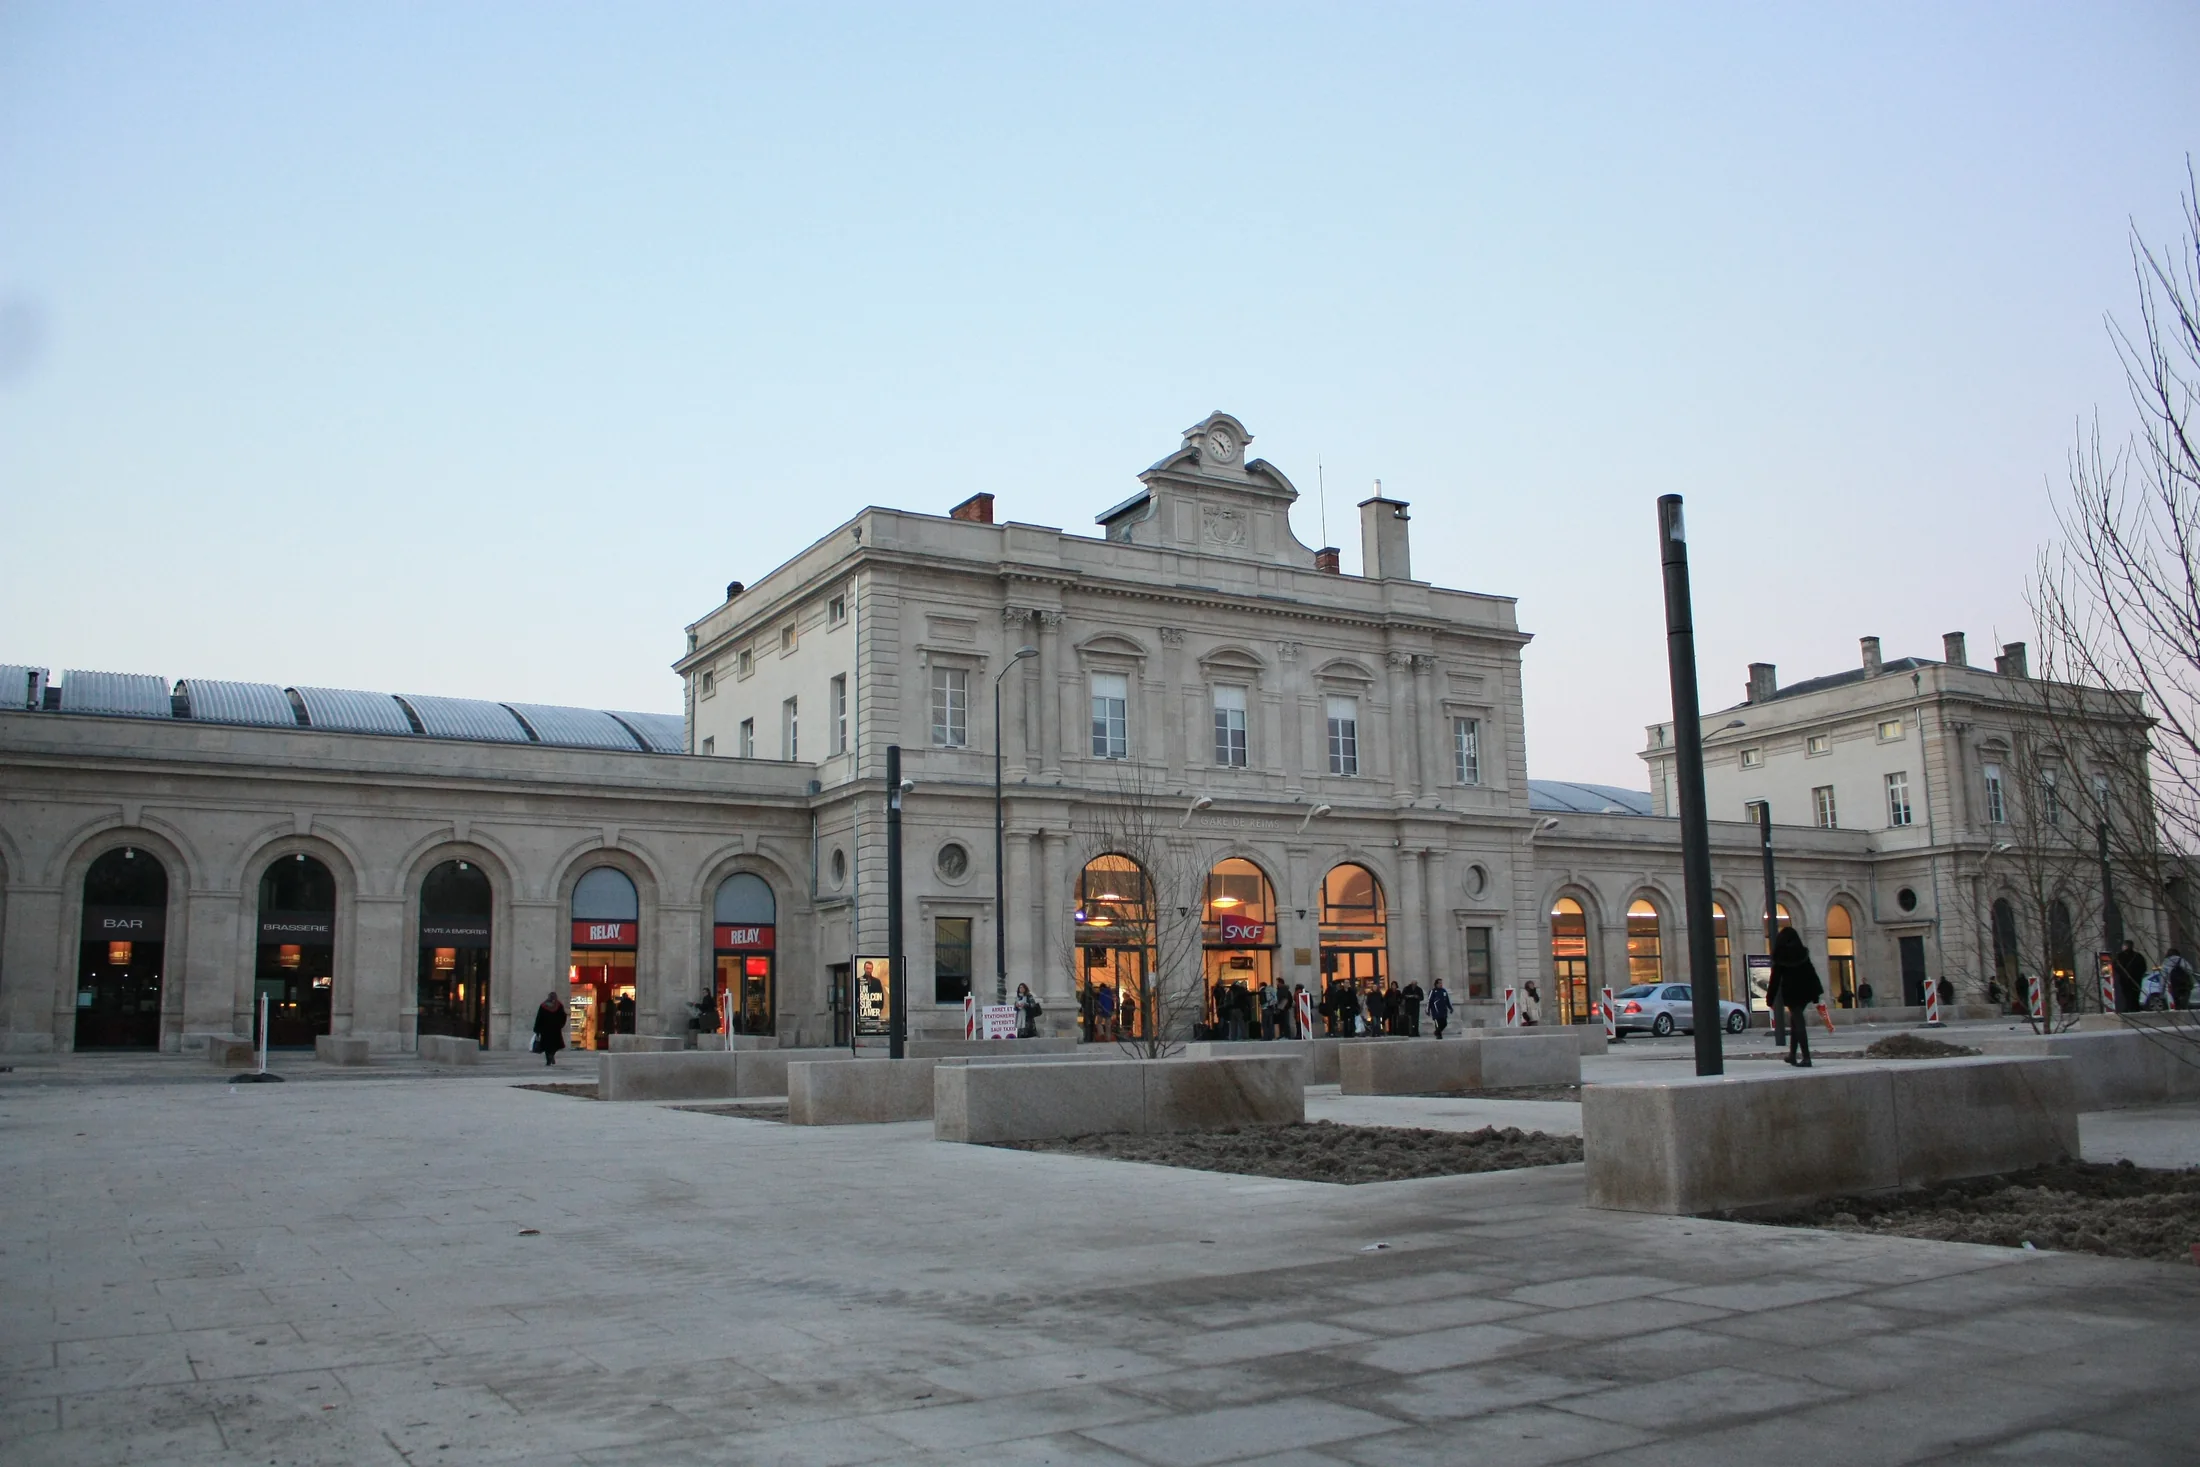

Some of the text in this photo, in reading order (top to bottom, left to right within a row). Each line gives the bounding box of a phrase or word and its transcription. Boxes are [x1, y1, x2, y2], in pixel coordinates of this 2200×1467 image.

[1200, 815, 1280, 829] GARE DE REIMS
[103, 918, 143, 928] BAR
[263, 923, 329, 932] BRASSERIE
[590, 923, 620, 940] RELAY
[1224, 925, 1263, 939] SNCF
[731, 928, 760, 945] RELAY
[859, 984, 869, 993] UN
[859, 992, 883, 1001] BALCON
[859, 1000, 872, 1009] SUR
[859, 1008, 880, 1017] LA MER
